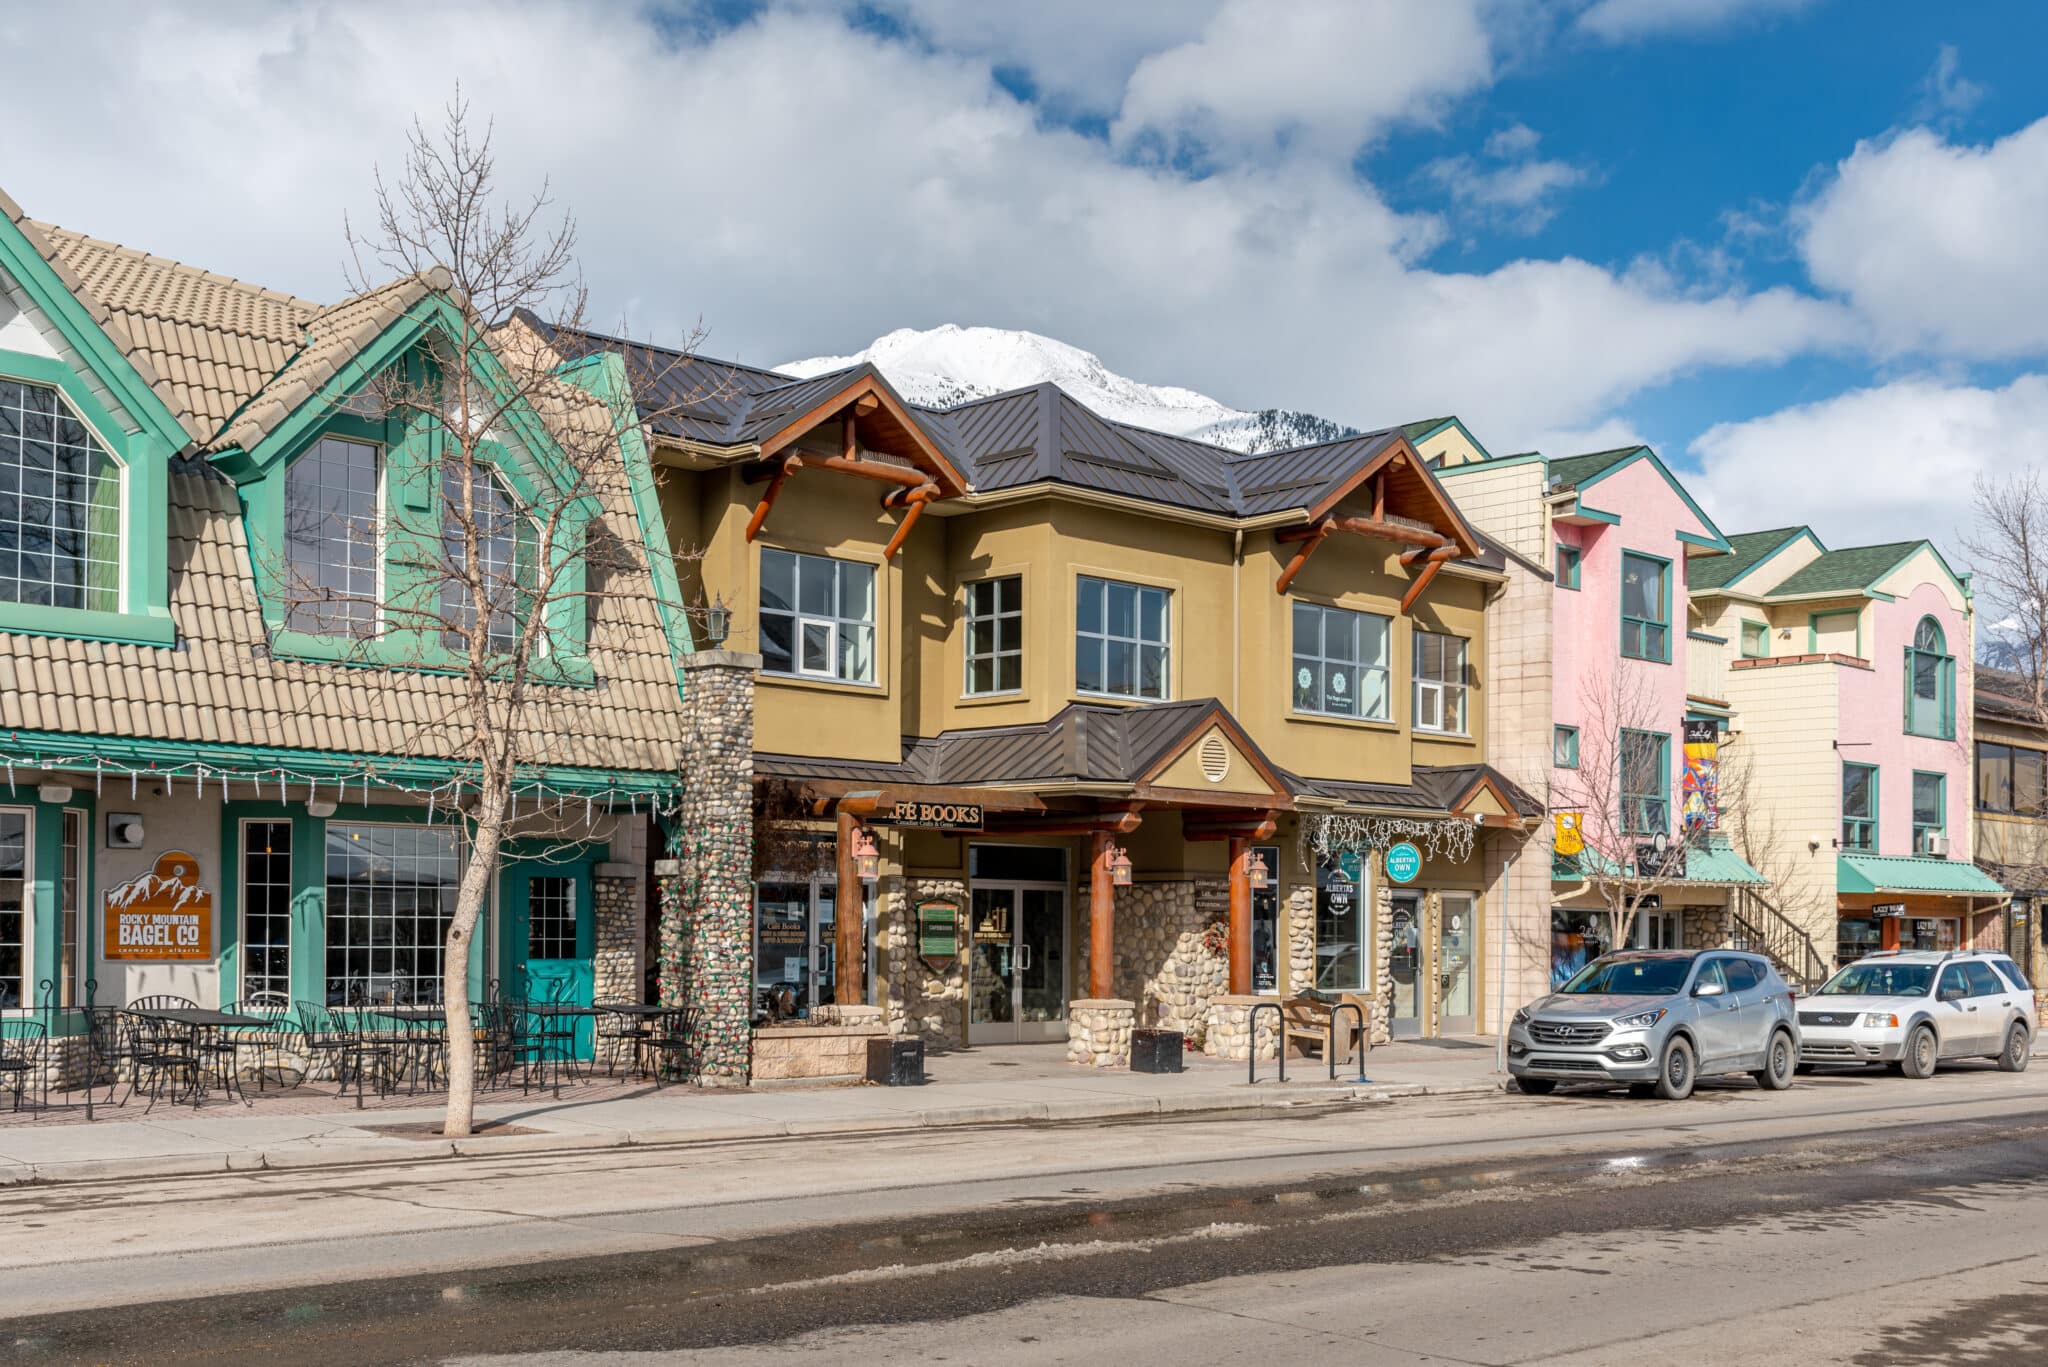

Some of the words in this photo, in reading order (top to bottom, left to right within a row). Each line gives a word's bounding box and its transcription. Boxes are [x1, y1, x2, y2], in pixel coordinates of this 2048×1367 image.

[920, 804, 979, 823] BOOKS
[1394, 864, 1411, 872] OWN
[1331, 893, 1348, 904] OWN
[119, 914, 149, 925] ROCKY
[152, 914, 199, 925] MOUNTAIN
[119, 925, 173, 945] BAGEL
[176, 925, 199, 945] CO
